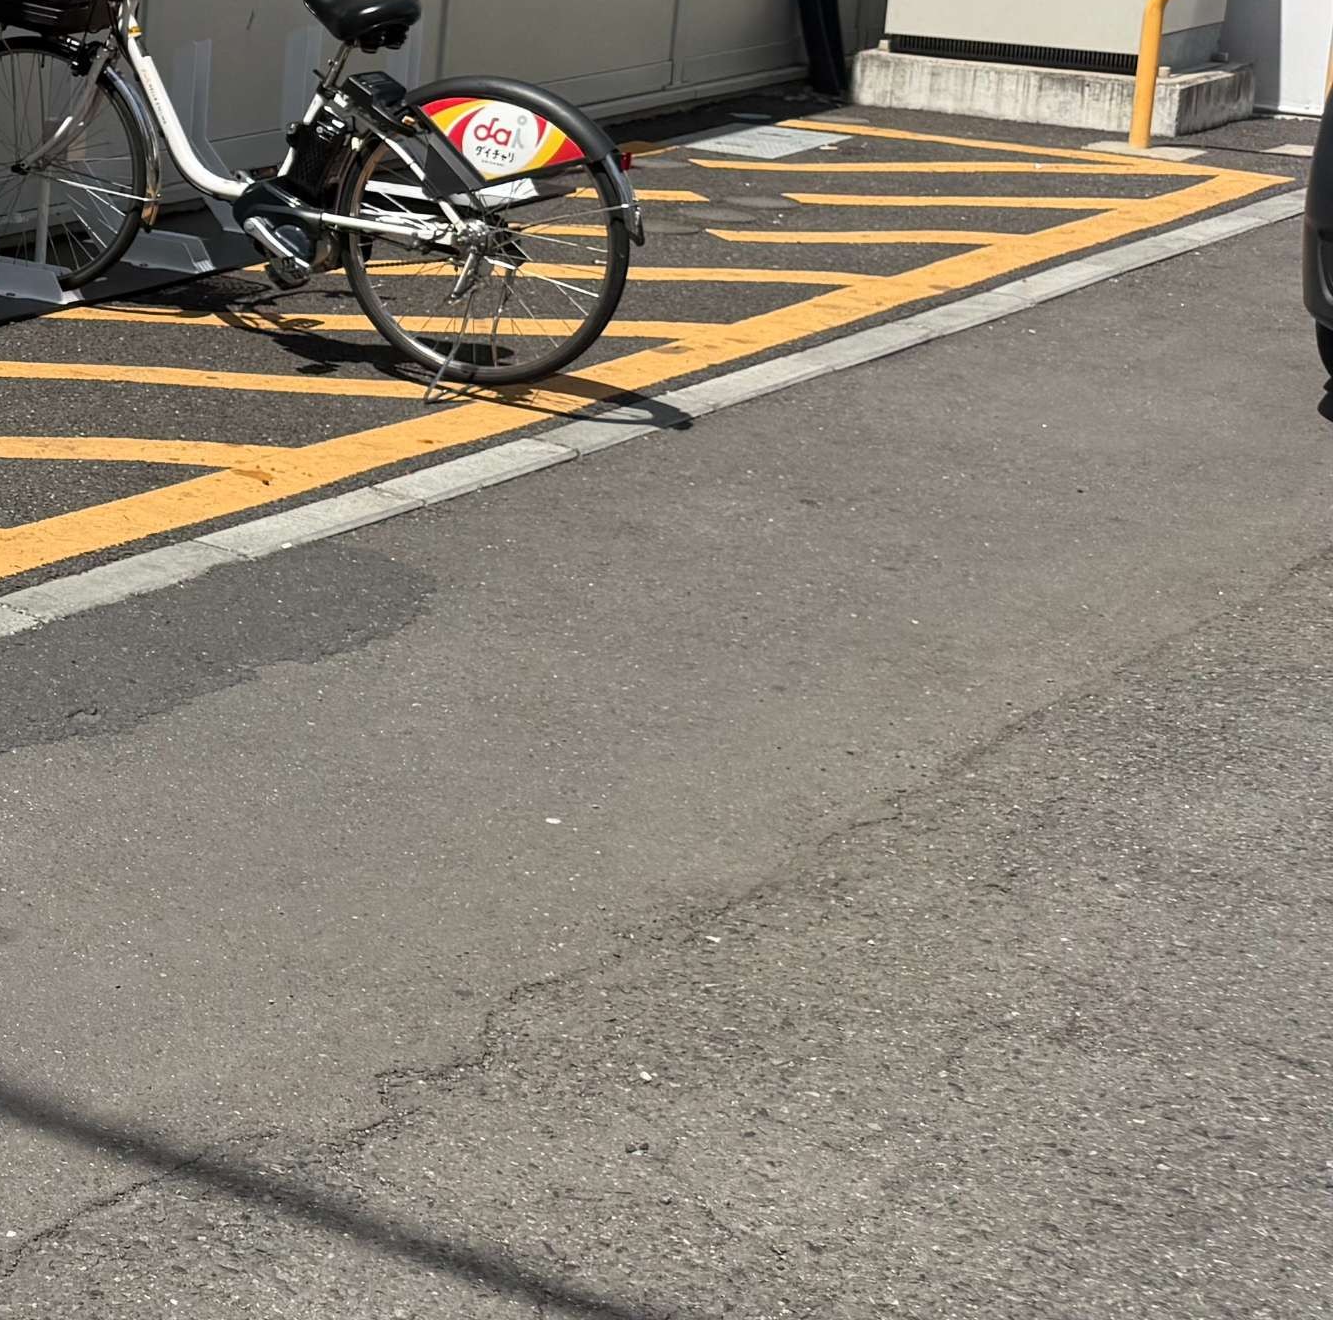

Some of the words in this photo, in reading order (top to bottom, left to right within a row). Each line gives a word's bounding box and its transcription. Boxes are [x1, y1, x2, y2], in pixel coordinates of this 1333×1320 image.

[474, 115, 527, 149] dai
[475, 145, 515, 163] ダイチャリ
